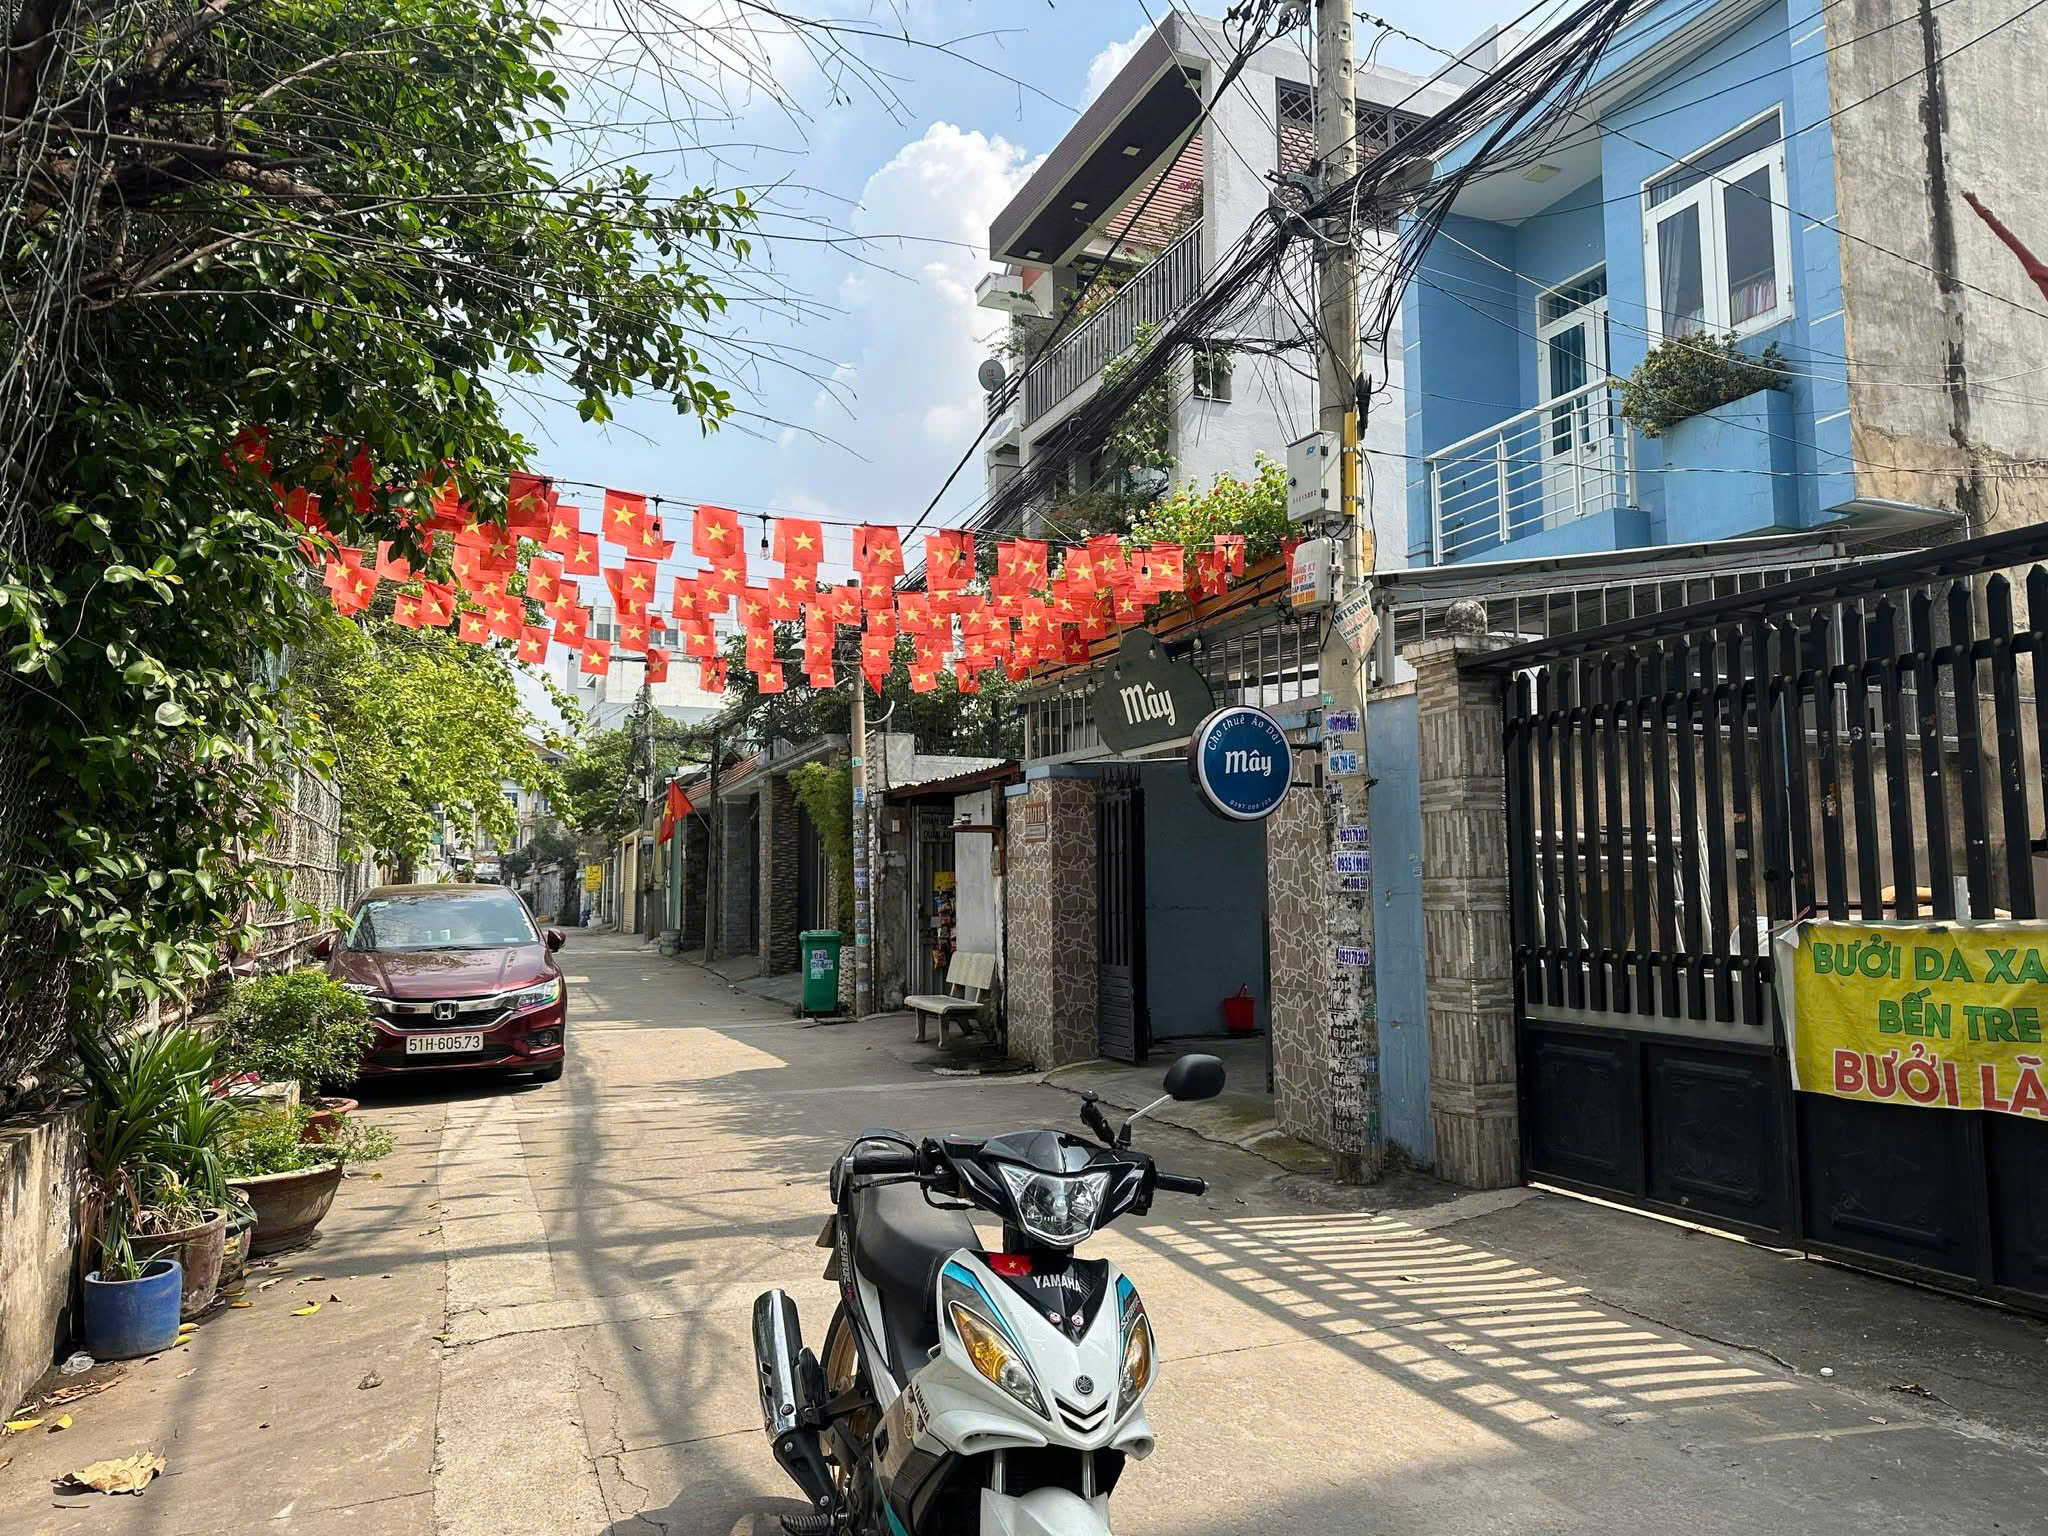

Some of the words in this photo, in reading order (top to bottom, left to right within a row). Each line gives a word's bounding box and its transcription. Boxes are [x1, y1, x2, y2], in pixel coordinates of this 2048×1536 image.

[1333, 595, 1369, 625] INTERN
[1119, 680, 1177, 727] Mây
[1207, 728, 1223, 751] Cho
[1222, 715, 1245, 732] thuê
[1250, 715, 1265, 729] Áo
[1224, 749, 1272, 777] Mây
[1813, 933, 1902, 980] BƯỞI
[1914, 946, 1975, 983] DA
[1984, 948, 2048, 984] XA
[1333, 1027, 1355, 1039] GÓP
[1878, 987, 1952, 1039] BẾN
[1962, 1005, 2042, 1043] TRE
[409, 1035, 481, 1052] 51H-605.73
[1833, 1043, 1961, 1107] BƯỞI
[1979, 1055, 2048, 1119] LÃ
[1032, 1273, 1082, 1294] YAMAHA
[914, 1382, 930, 1424] YAMAHA
